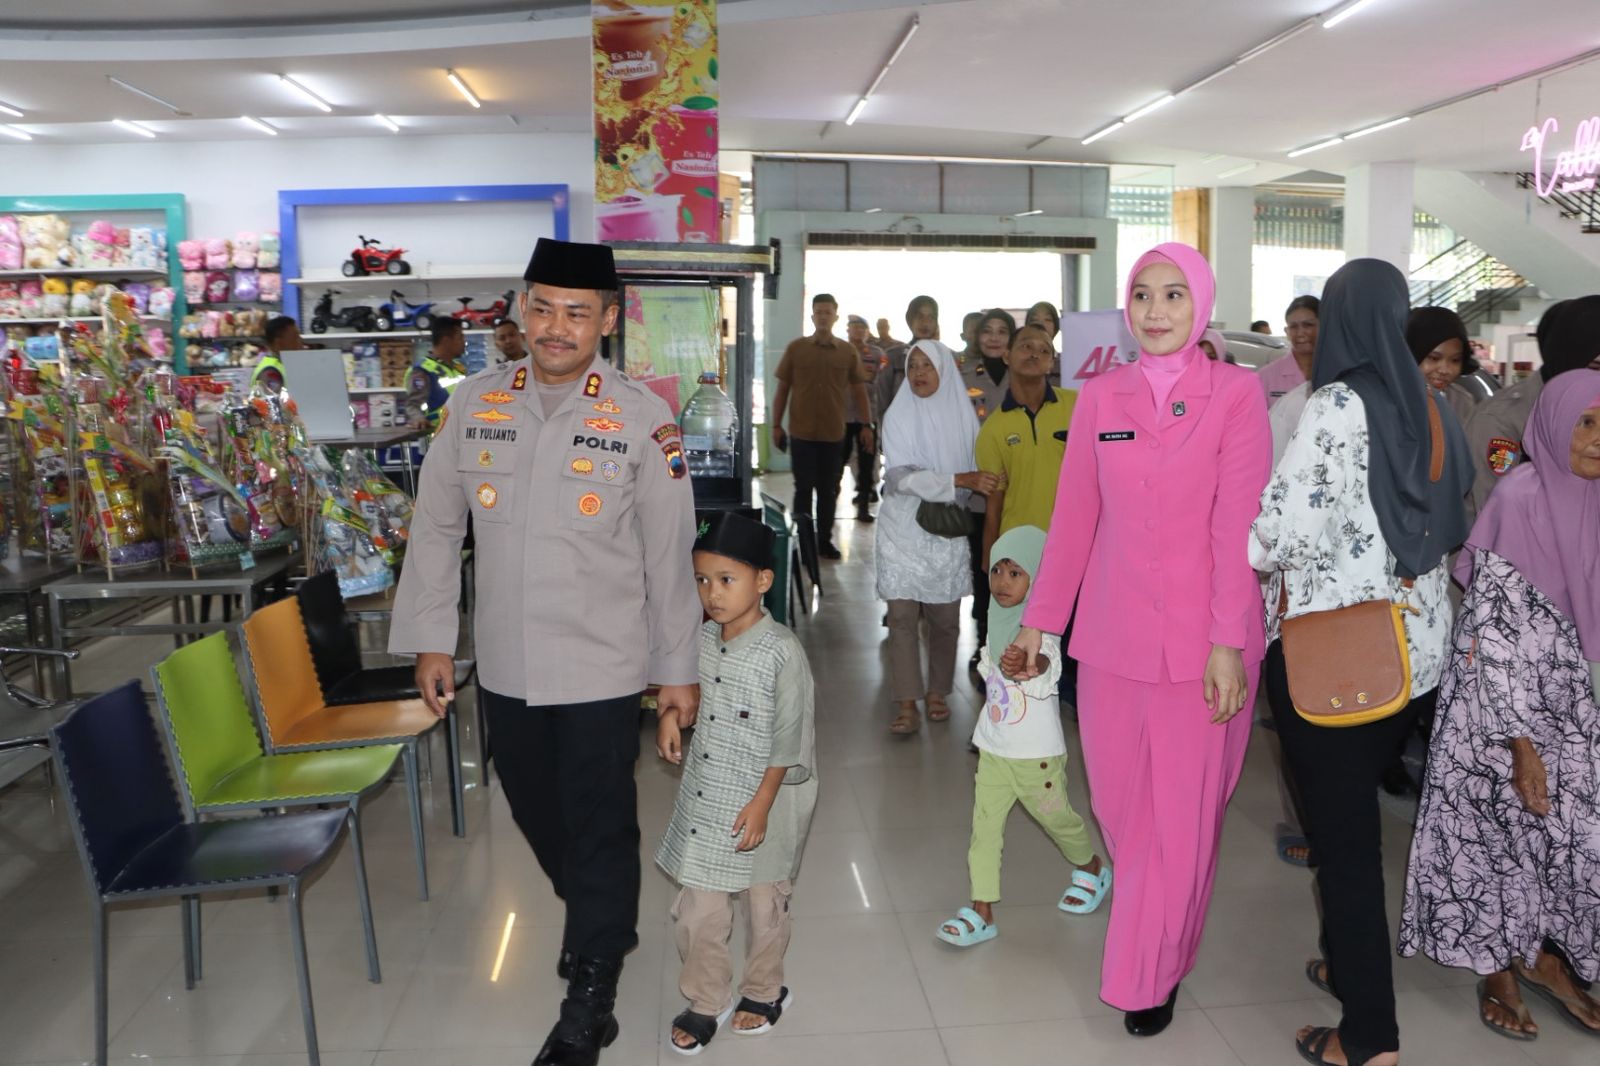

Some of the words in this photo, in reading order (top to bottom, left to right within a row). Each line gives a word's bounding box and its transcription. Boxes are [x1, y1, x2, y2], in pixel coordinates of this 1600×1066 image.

[610, 52, 624, 61] Es
[626, 50, 643, 59] Teh
[696, 151, 711, 159] Teh
[466, 427, 477, 439] IKE
[480, 427, 517, 442] YULIANTO
[573, 435, 628, 455] POLRI
